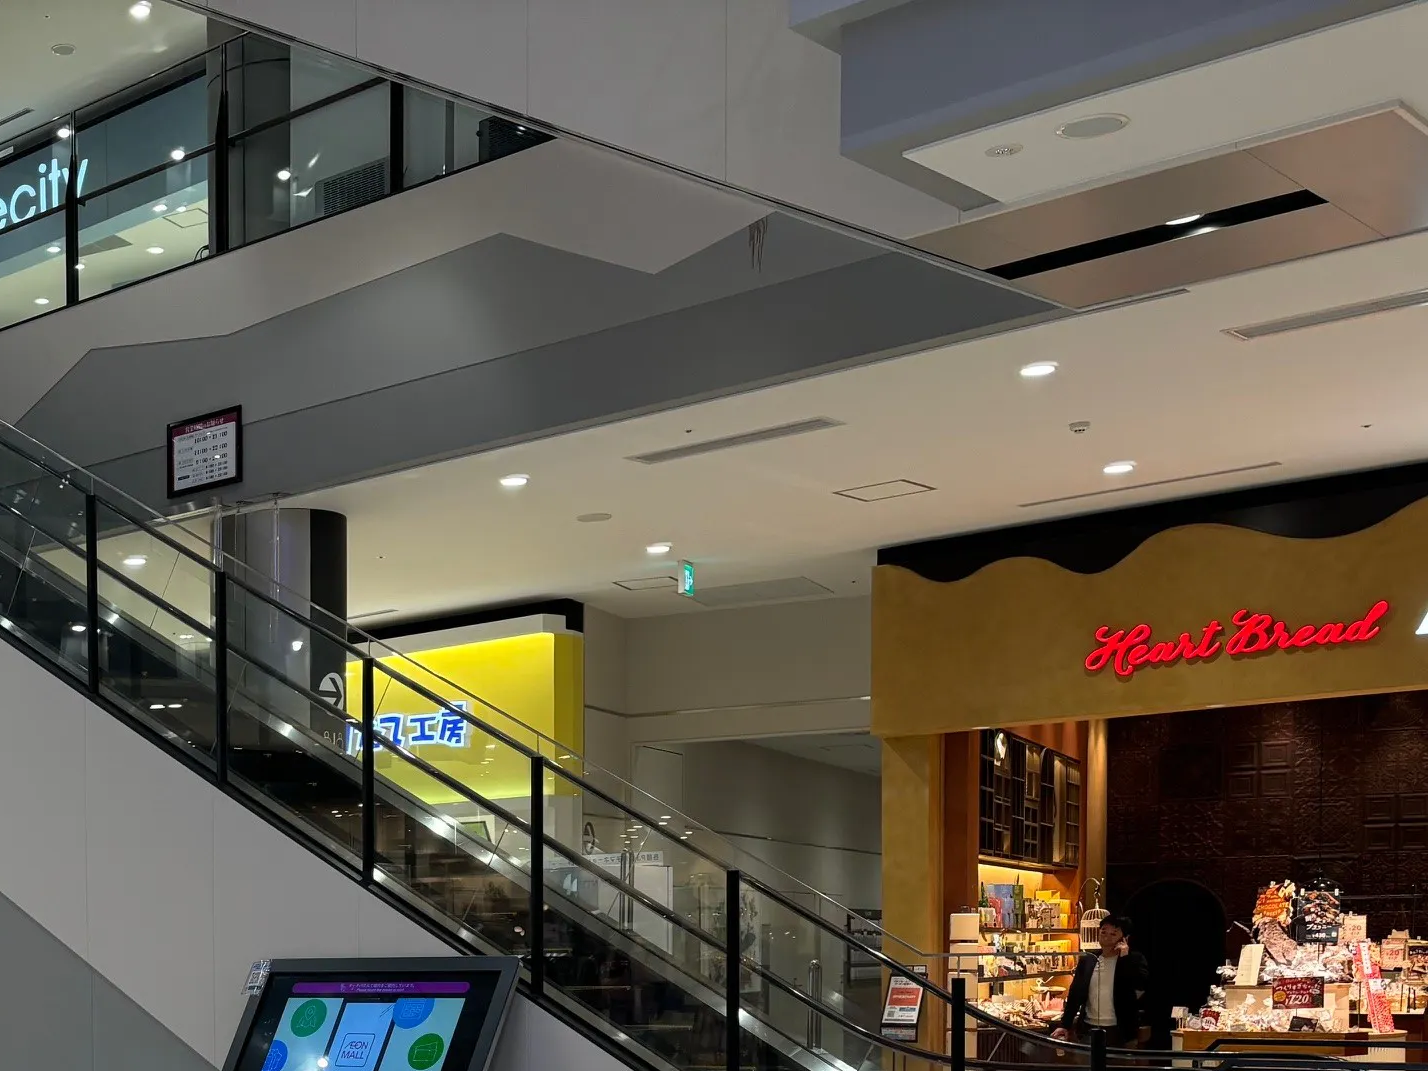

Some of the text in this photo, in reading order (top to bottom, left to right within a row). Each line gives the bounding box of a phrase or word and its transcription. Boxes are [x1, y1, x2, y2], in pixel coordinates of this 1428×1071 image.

[1084, 620, 1224, 676] Heart
[1225, 599, 1390, 656] Bread
[341, 1050, 364, 1060] MALL
